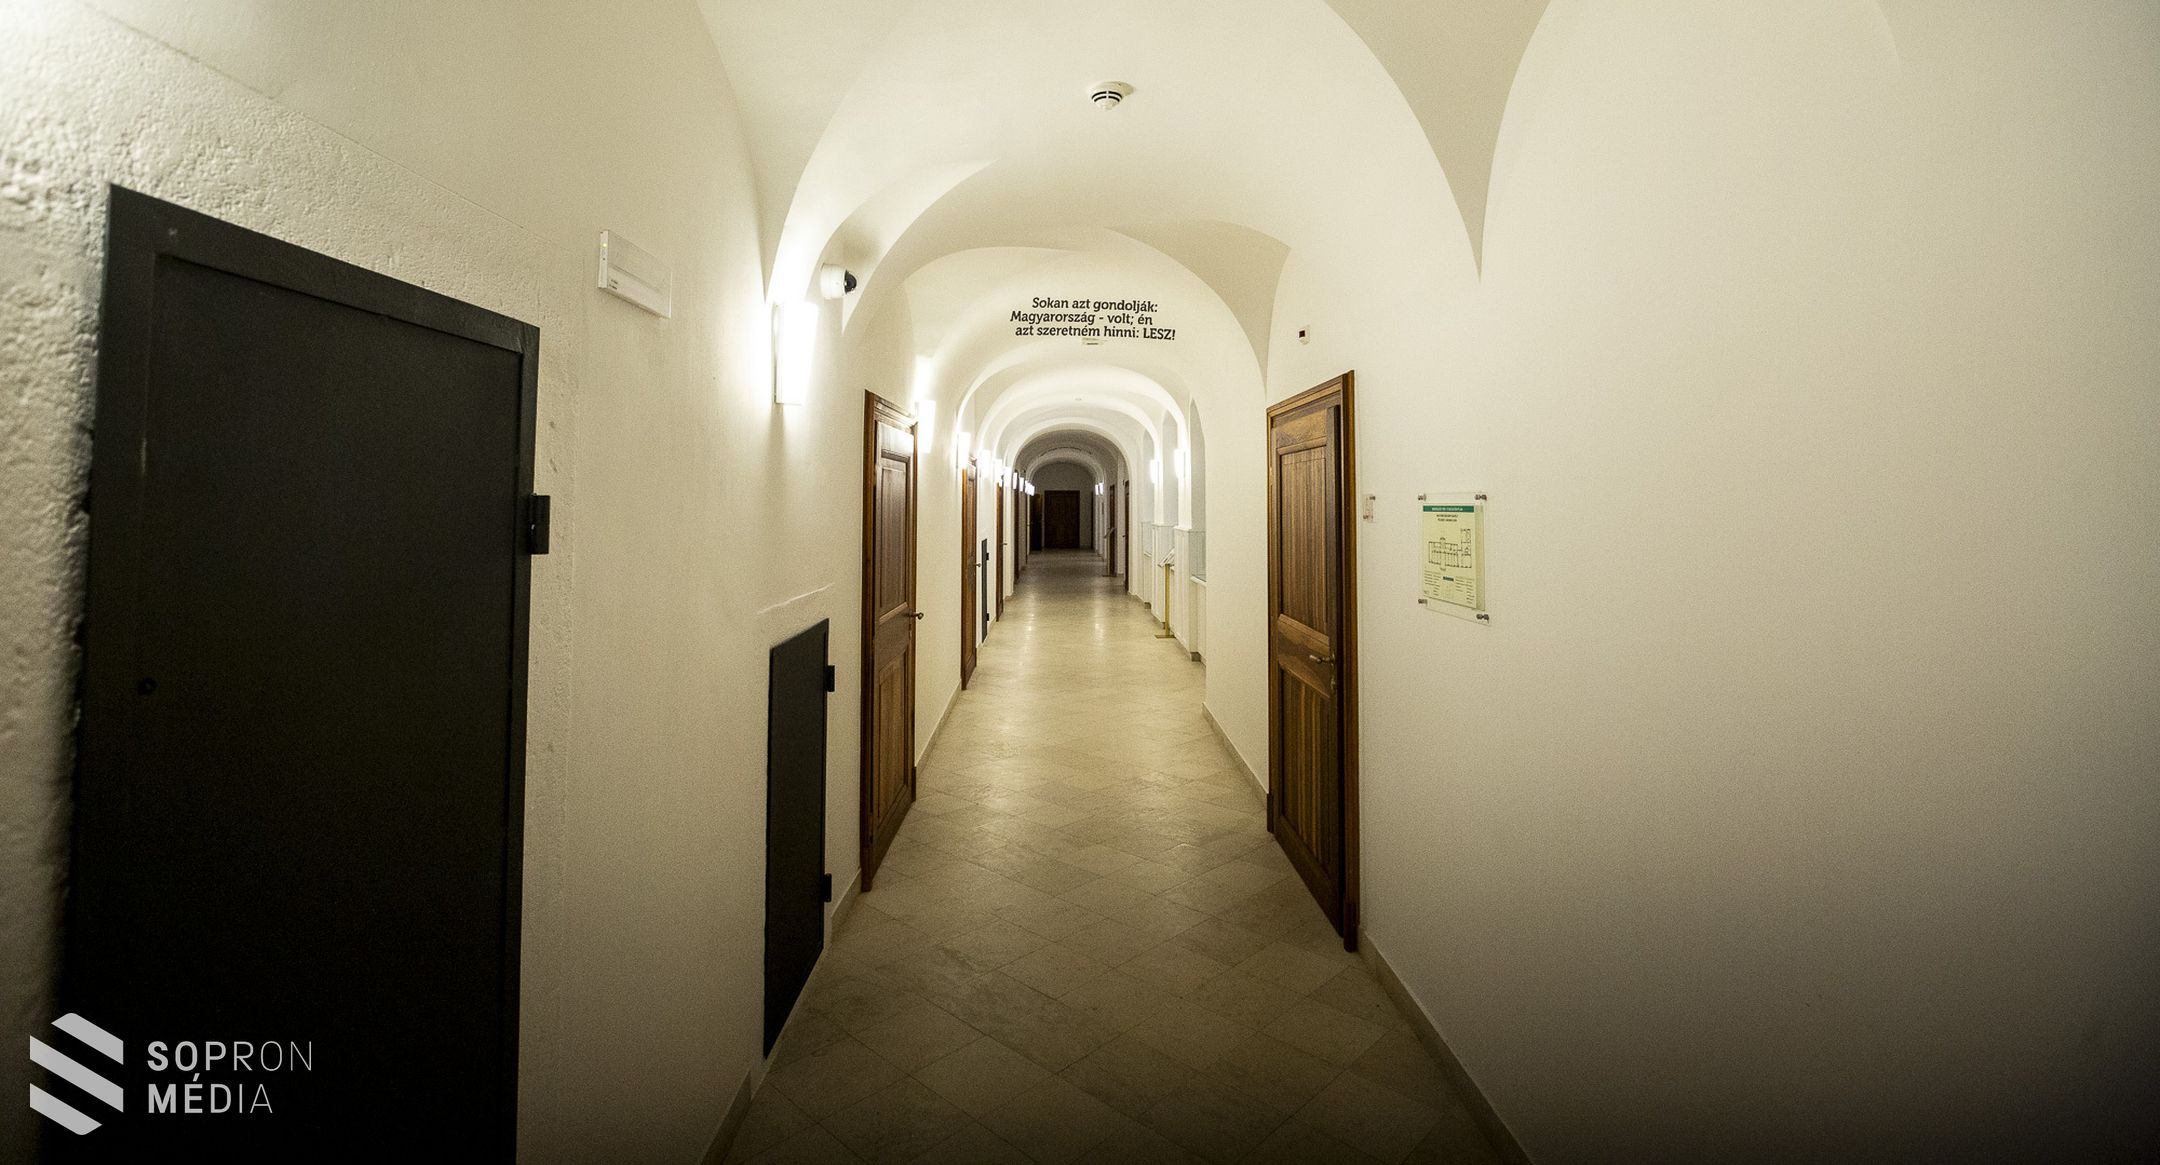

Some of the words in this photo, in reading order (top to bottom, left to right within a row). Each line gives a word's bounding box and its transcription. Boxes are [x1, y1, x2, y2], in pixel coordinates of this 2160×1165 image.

[1032, 297, 1069, 309] Sokan
[1072, 299, 1091, 309] azt
[1093, 300, 1158, 314] gondolják:
[1010, 311, 1096, 325] Magyarország
[1107, 313, 1135, 325] volt;
[1138, 313, 1153, 325] én
[1015, 325, 1034, 336] azt
[1037, 325, 1101, 337] szeretném
[1103, 326, 1139, 338] hinni:
[1143, 327, 1177, 340] LESZ!
